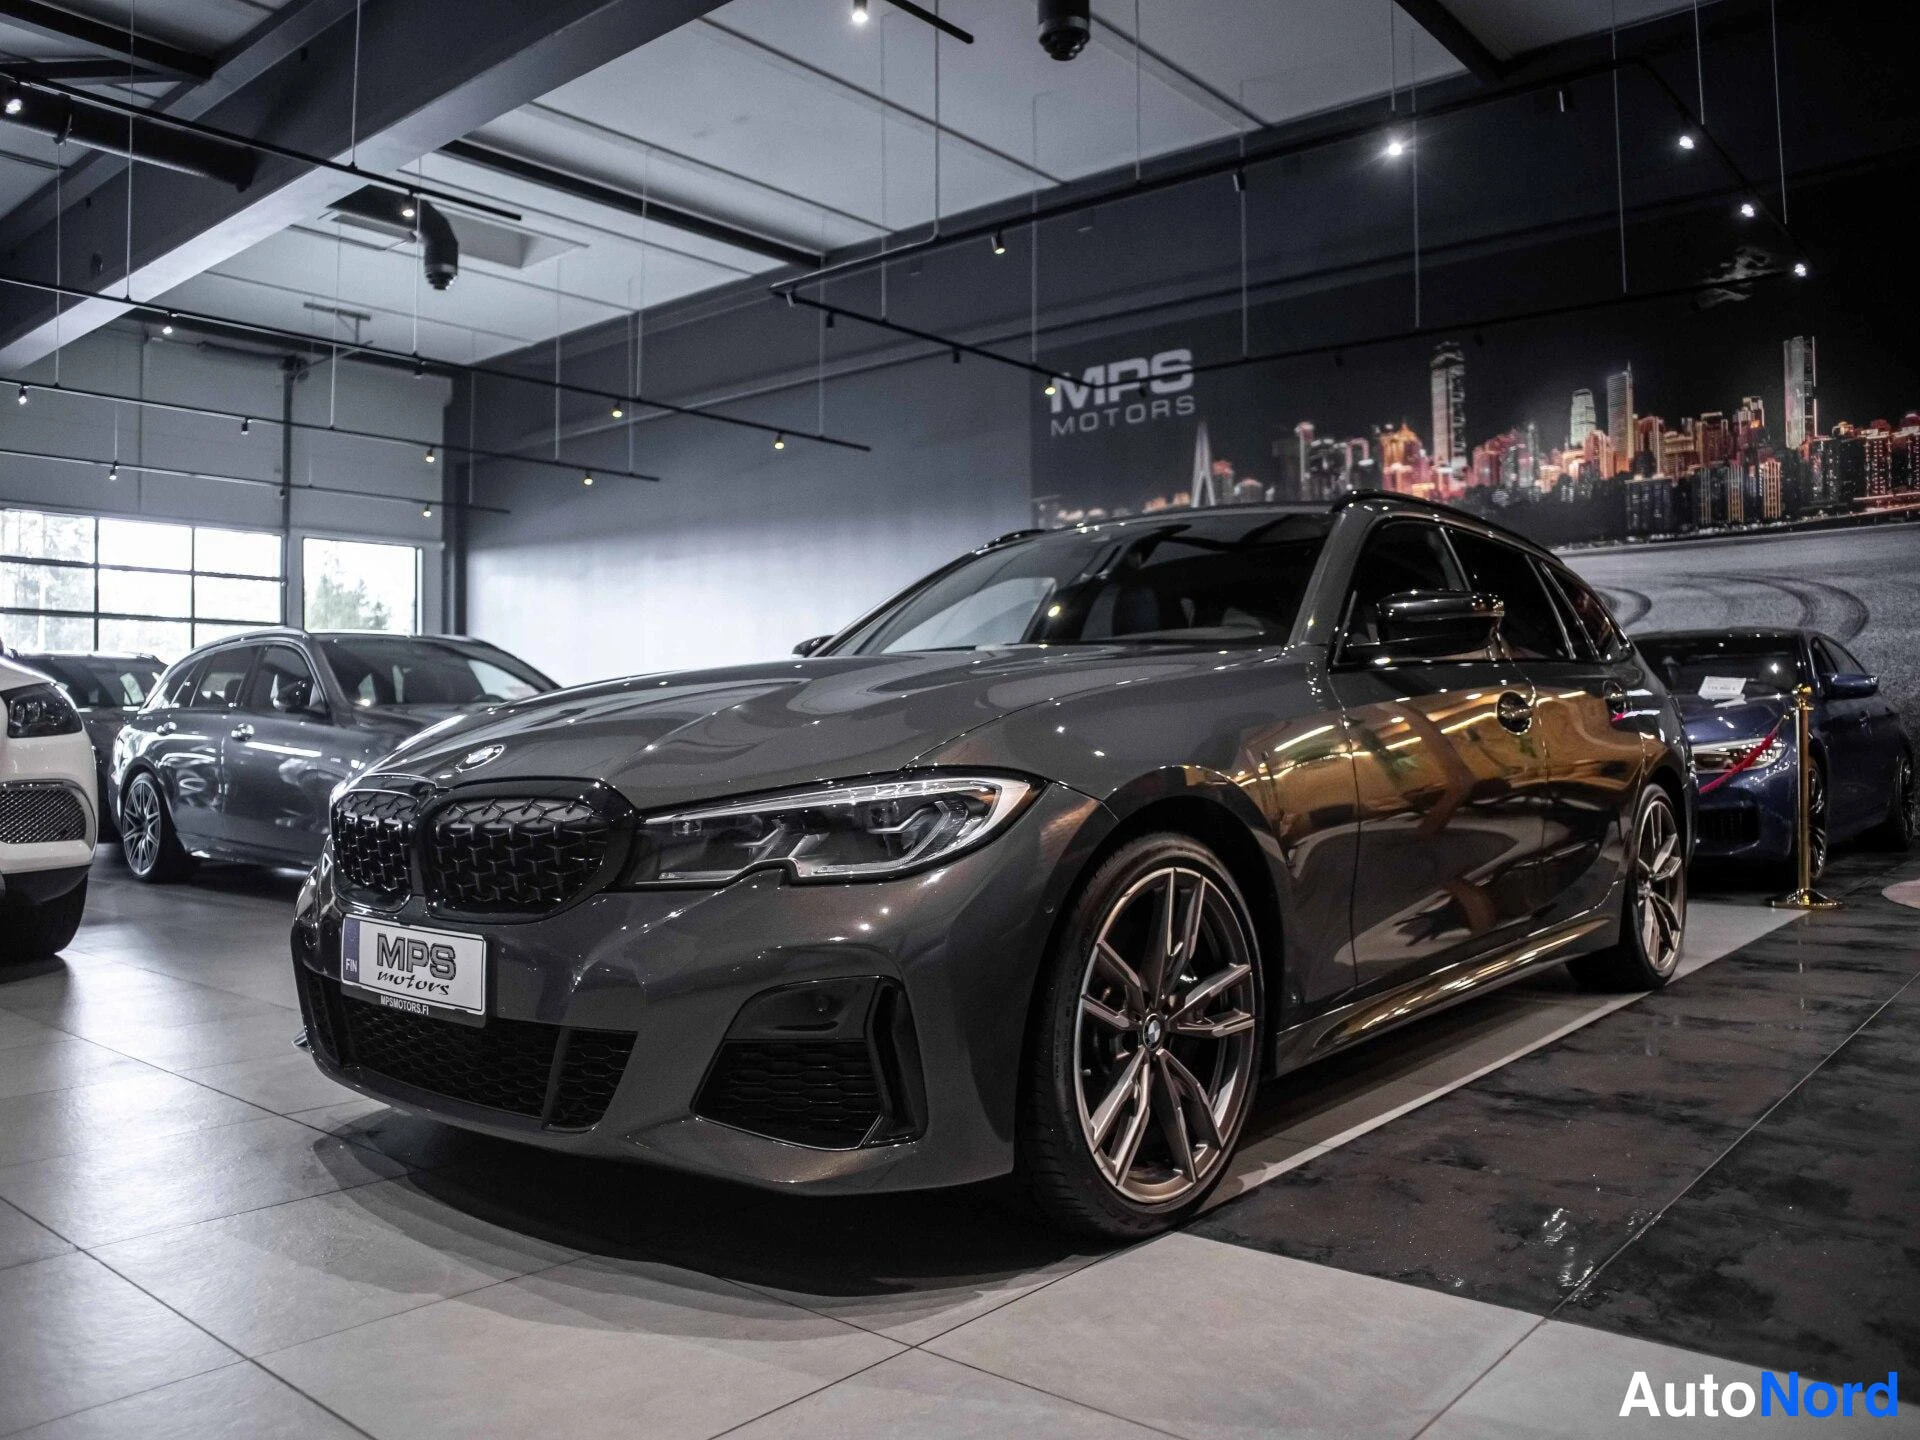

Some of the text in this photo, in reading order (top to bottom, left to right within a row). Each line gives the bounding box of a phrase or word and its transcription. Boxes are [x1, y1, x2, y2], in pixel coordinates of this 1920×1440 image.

[1051, 349, 1194, 413] MPS
[1051, 395, 1196, 437] MOTORS
[345, 958, 358, 973] FIN
[376, 932, 457, 981] MPS
[377, 970, 450, 996] motors
[380, 994, 429, 1016] MPSMOTORS.FI
